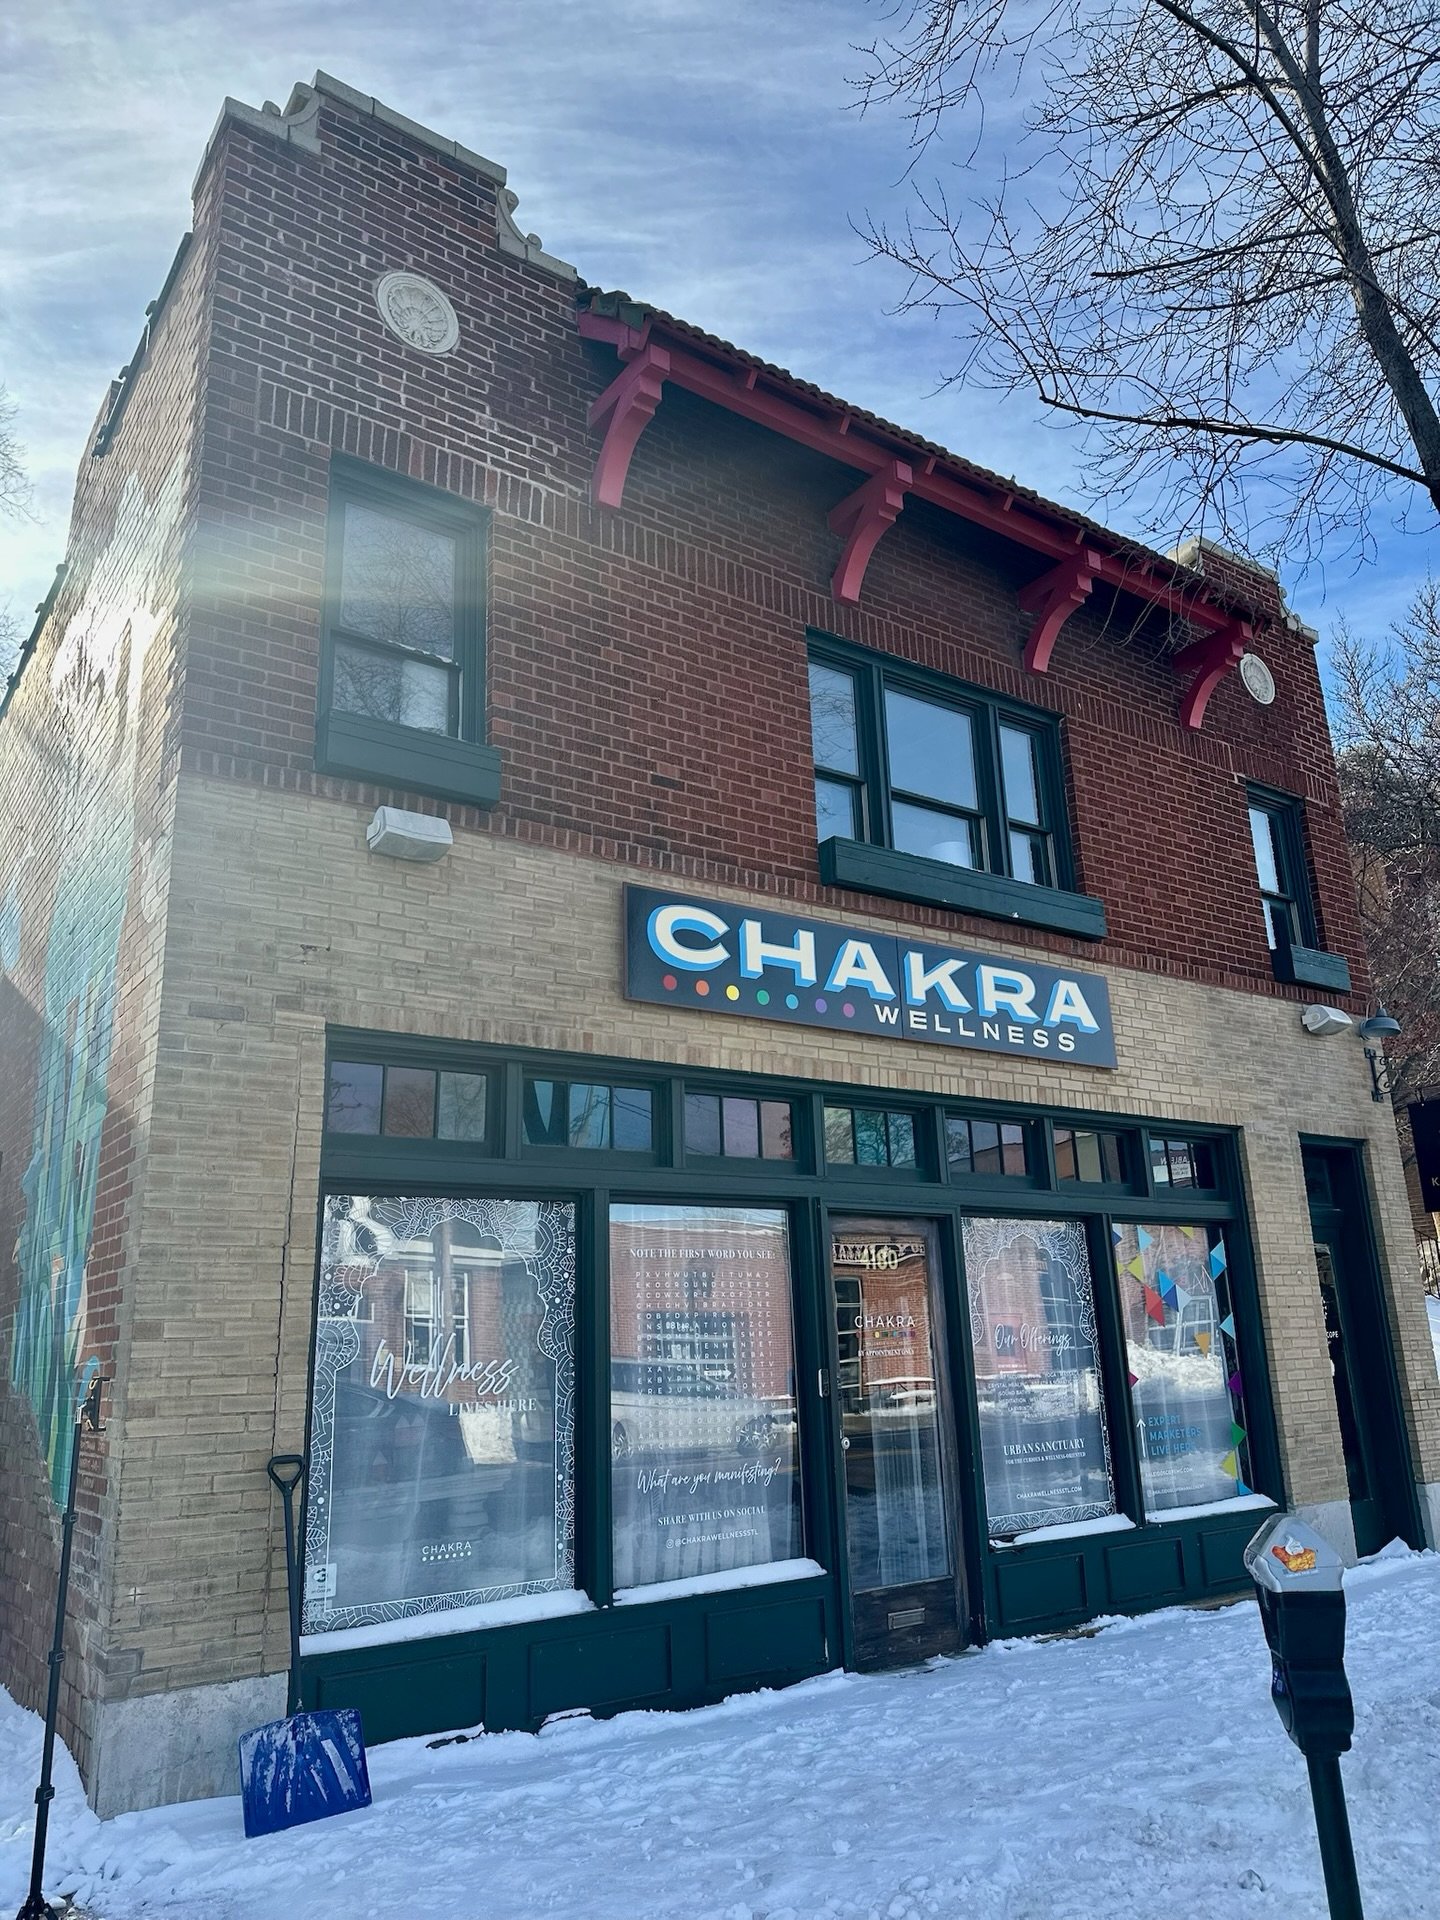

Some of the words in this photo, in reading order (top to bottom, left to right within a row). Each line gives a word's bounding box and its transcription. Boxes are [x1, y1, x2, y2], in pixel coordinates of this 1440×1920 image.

[647, 904, 1101, 1034] CHAKRA
[873, 1003, 1076, 1052] WELLNESS
[630, 1248, 656, 1259] NOTE
[658, 1248, 678, 1259] THE
[680, 1248, 706, 1259] FIRST
[707, 1249, 736, 1259] WORD
[737, 1249, 755, 1259] YOU
[854, 1315, 916, 1328] CHAKRA
[994, 1323, 1019, 1349] Our
[1020, 1322, 1072, 1356] Offerings
[370, 1333, 520, 1400] Wellness
[448, 1401, 493, 1417] LIVES
[497, 1398, 537, 1412] HERE
[1147, 1414, 1181, 1427] EXPERT
[1149, 1427, 1201, 1441] MARKETERS
[1003, 1442, 1035, 1456] URBAN
[1034, 1438, 1086, 1454] SANCTUARY
[1151, 1445, 1170, 1456] LIVE
[637, 1468, 672, 1494] What
[671, 1474, 692, 1487] are
[689, 1470, 710, 1494] you
[714, 1457, 782, 1487] manifesting?
[658, 1513, 687, 1527] SHARE
[688, 1510, 711, 1523] WITH
[712, 1508, 723, 1520] US
[723, 1508, 735, 1519] ON
[737, 1505, 766, 1517] SOCIAL
[422, 1541, 472, 1555] CHAKRA
